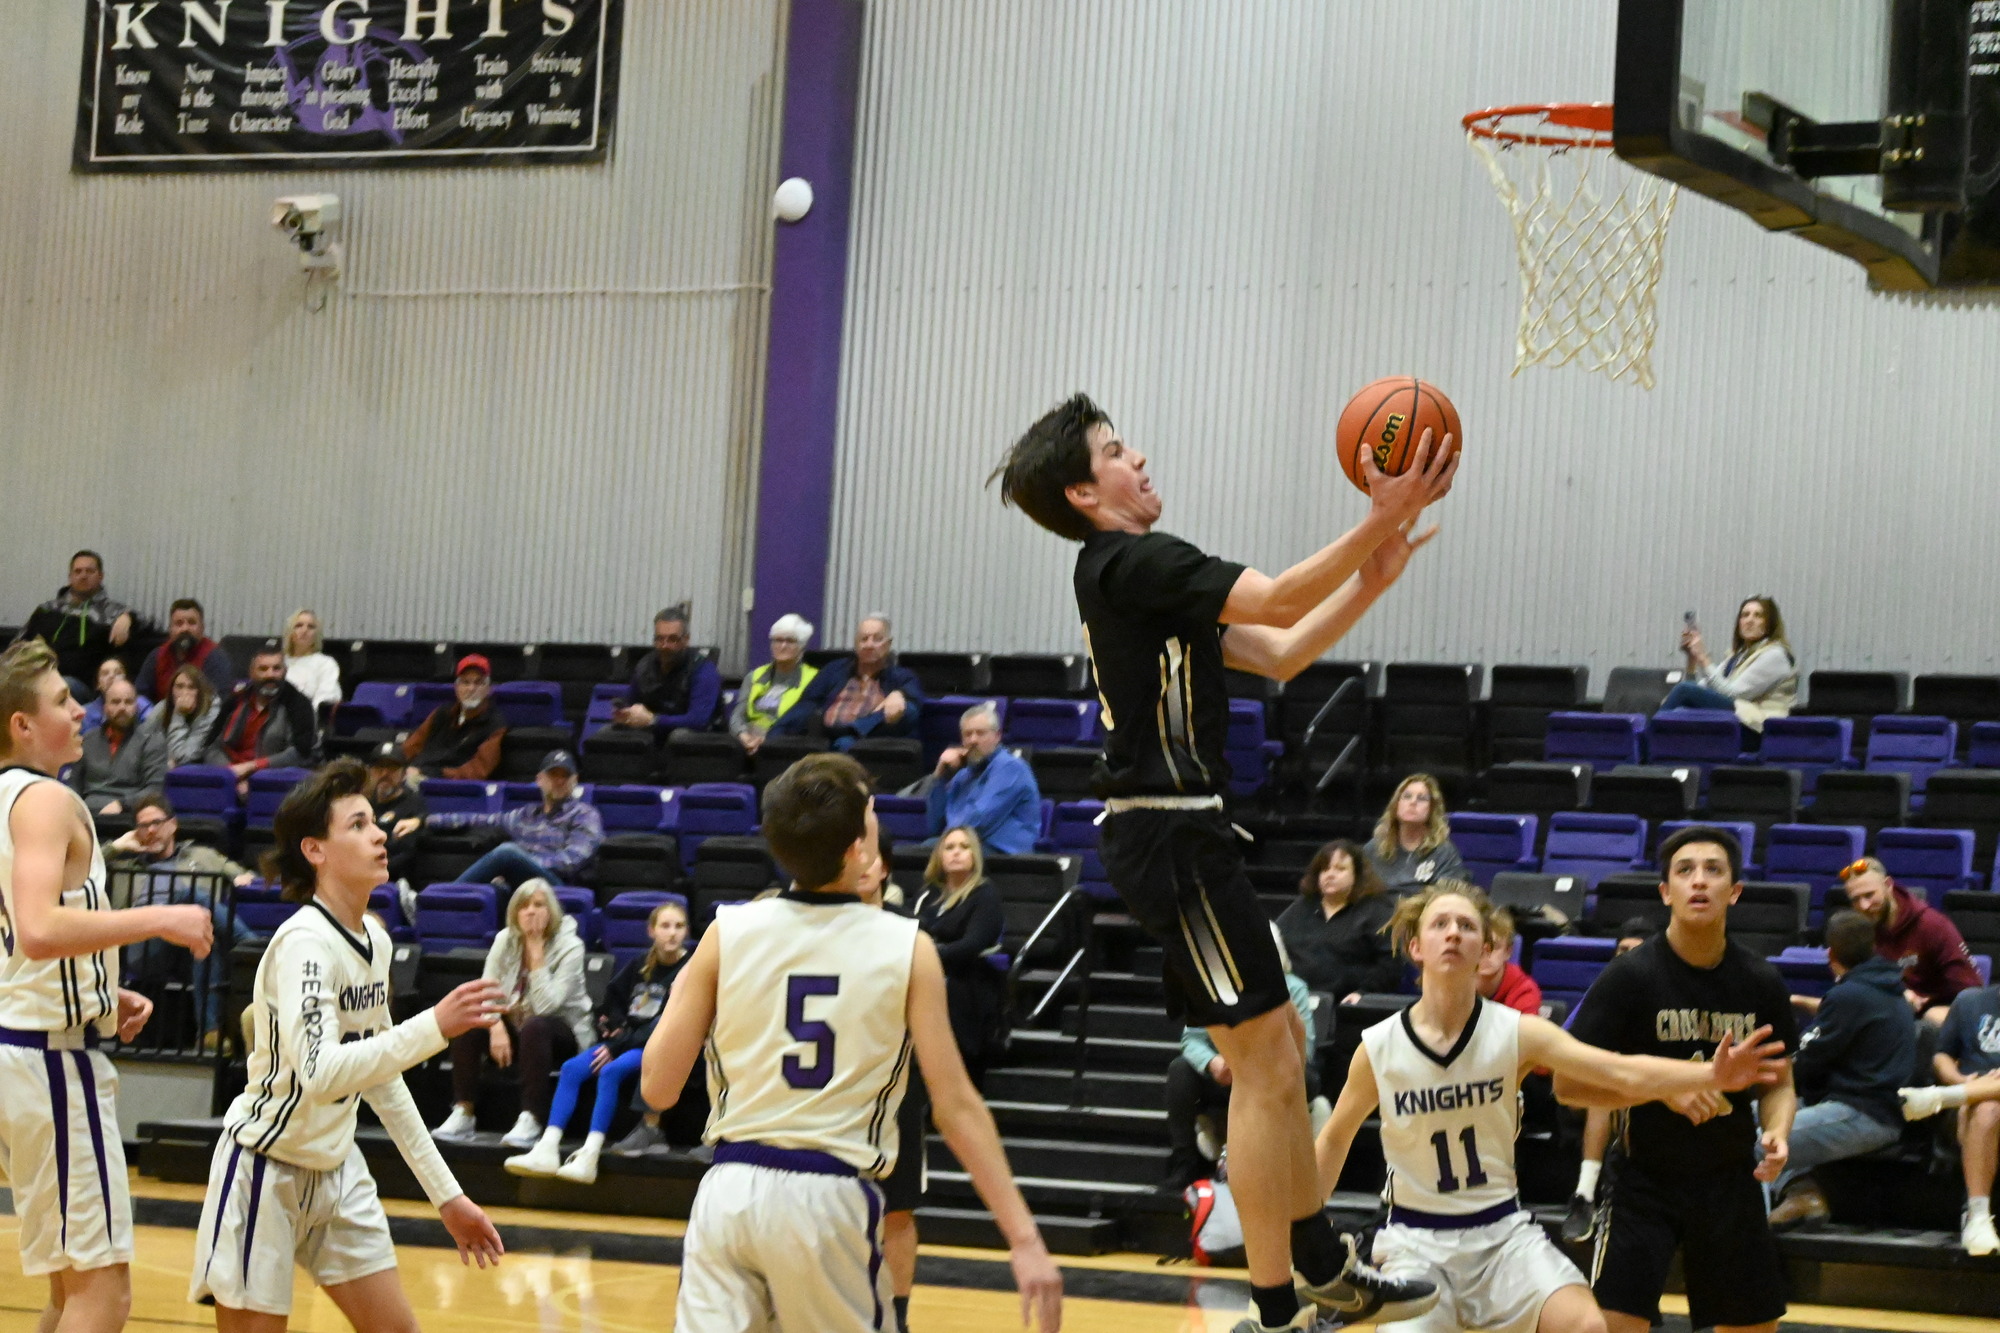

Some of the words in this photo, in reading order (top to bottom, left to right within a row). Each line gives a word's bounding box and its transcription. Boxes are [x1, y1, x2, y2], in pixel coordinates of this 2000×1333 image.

[111, 0, 575, 50] KNIGHTS
[115, 64, 151, 86] Know
[184, 63, 215, 84] Now
[245, 61, 288, 87] Impact
[321, 60, 357, 85] Glory
[473, 53, 509, 75] Train
[529, 51, 582, 78] Striving
[180, 87, 192, 108] is
[193, 87, 215, 108] the
[241, 84, 289, 111] through
[304, 84, 319, 105] in
[320, 83, 372, 109] pleasing
[387, 80, 423, 103] Excel
[423, 81, 438, 102] in
[475, 78, 503, 100] with
[549, 76, 561, 98] is
[114, 113, 145, 135] Role
[177, 112, 209, 134] Time
[229, 112, 293, 133] Character
[322, 109, 351, 131] God
[392, 106, 430, 130] Effort
[459, 105, 514, 131] Urgency
[525, 103, 581, 129] Winning
[338, 981, 387, 1012] KNIGHTS
[781, 974, 840, 1090] 5
[1394, 1076, 1504, 1116] KNIGHTS
[1429, 1123, 1488, 1194] 11
